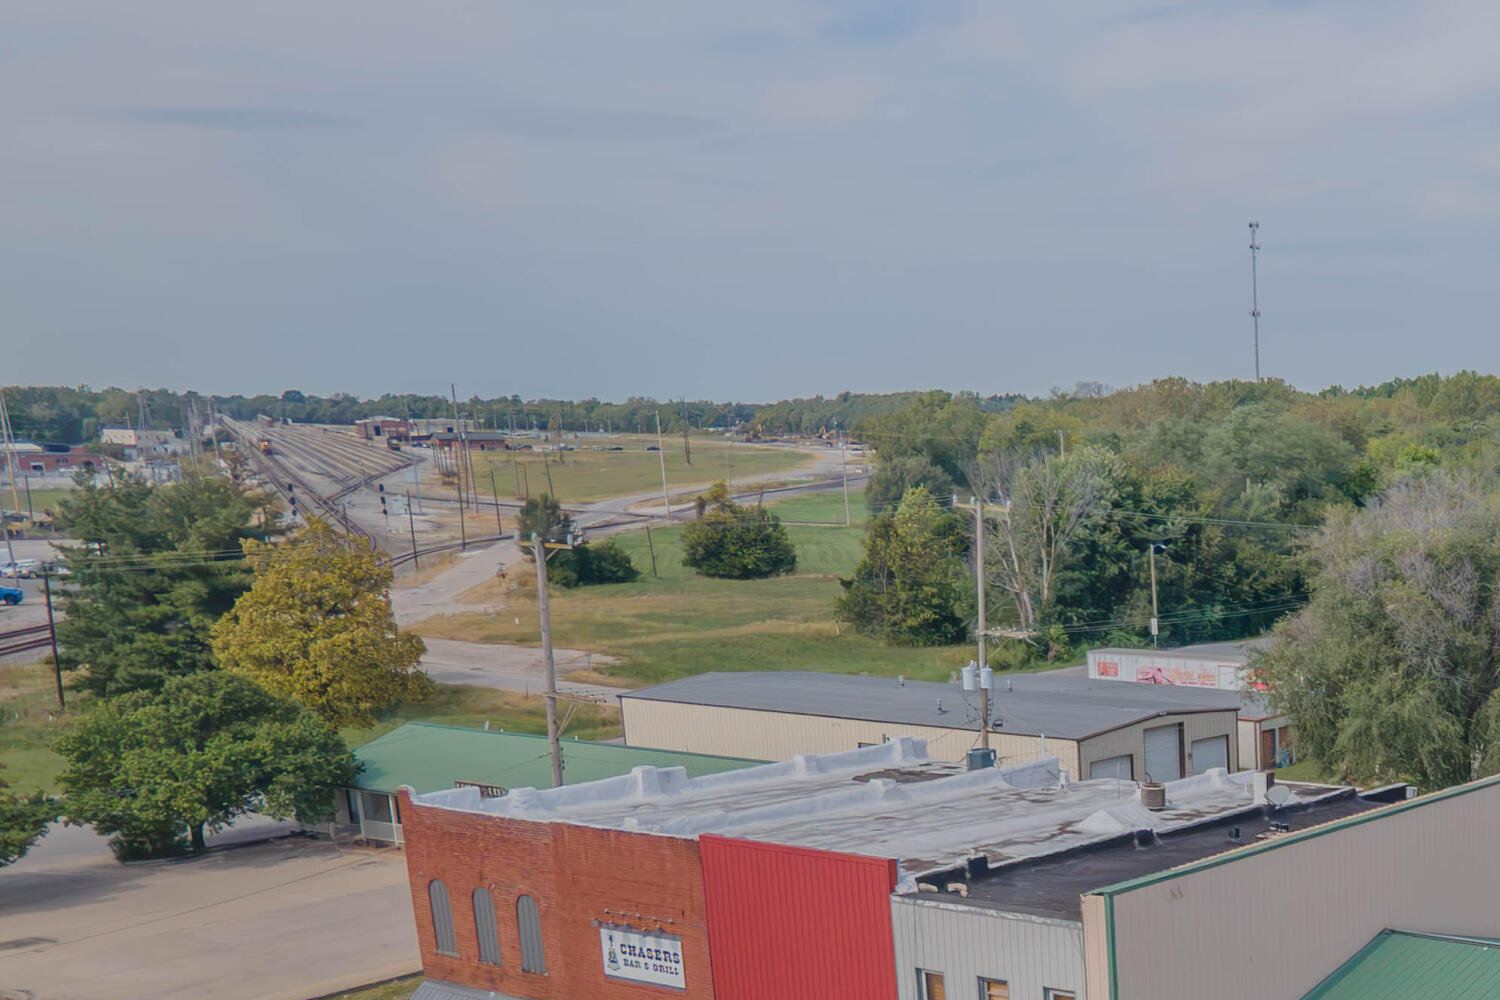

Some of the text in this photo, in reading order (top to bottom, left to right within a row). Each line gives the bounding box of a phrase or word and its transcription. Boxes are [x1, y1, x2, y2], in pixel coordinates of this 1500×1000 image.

[620, 943, 680, 964] CHASERS
[623, 958, 641, 969] BAR
[653, 963, 679, 976] GRILL
